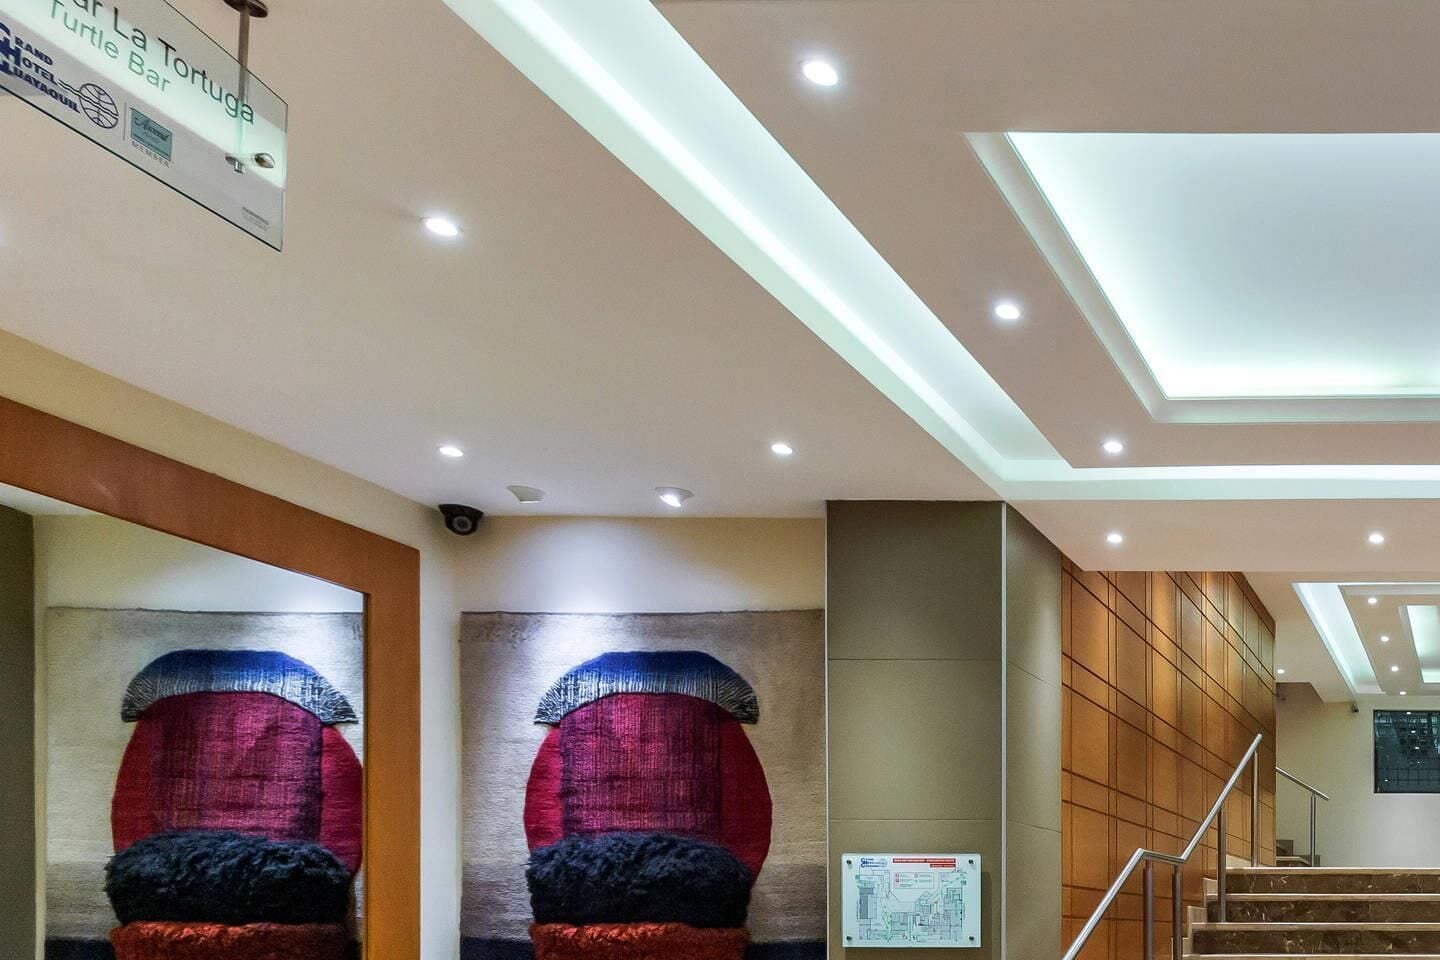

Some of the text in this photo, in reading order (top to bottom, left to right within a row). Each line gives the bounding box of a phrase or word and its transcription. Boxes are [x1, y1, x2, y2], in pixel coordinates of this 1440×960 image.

[50, 0, 171, 92] Turtle Bar
[73, 0, 255, 125] ar La Tortuga
